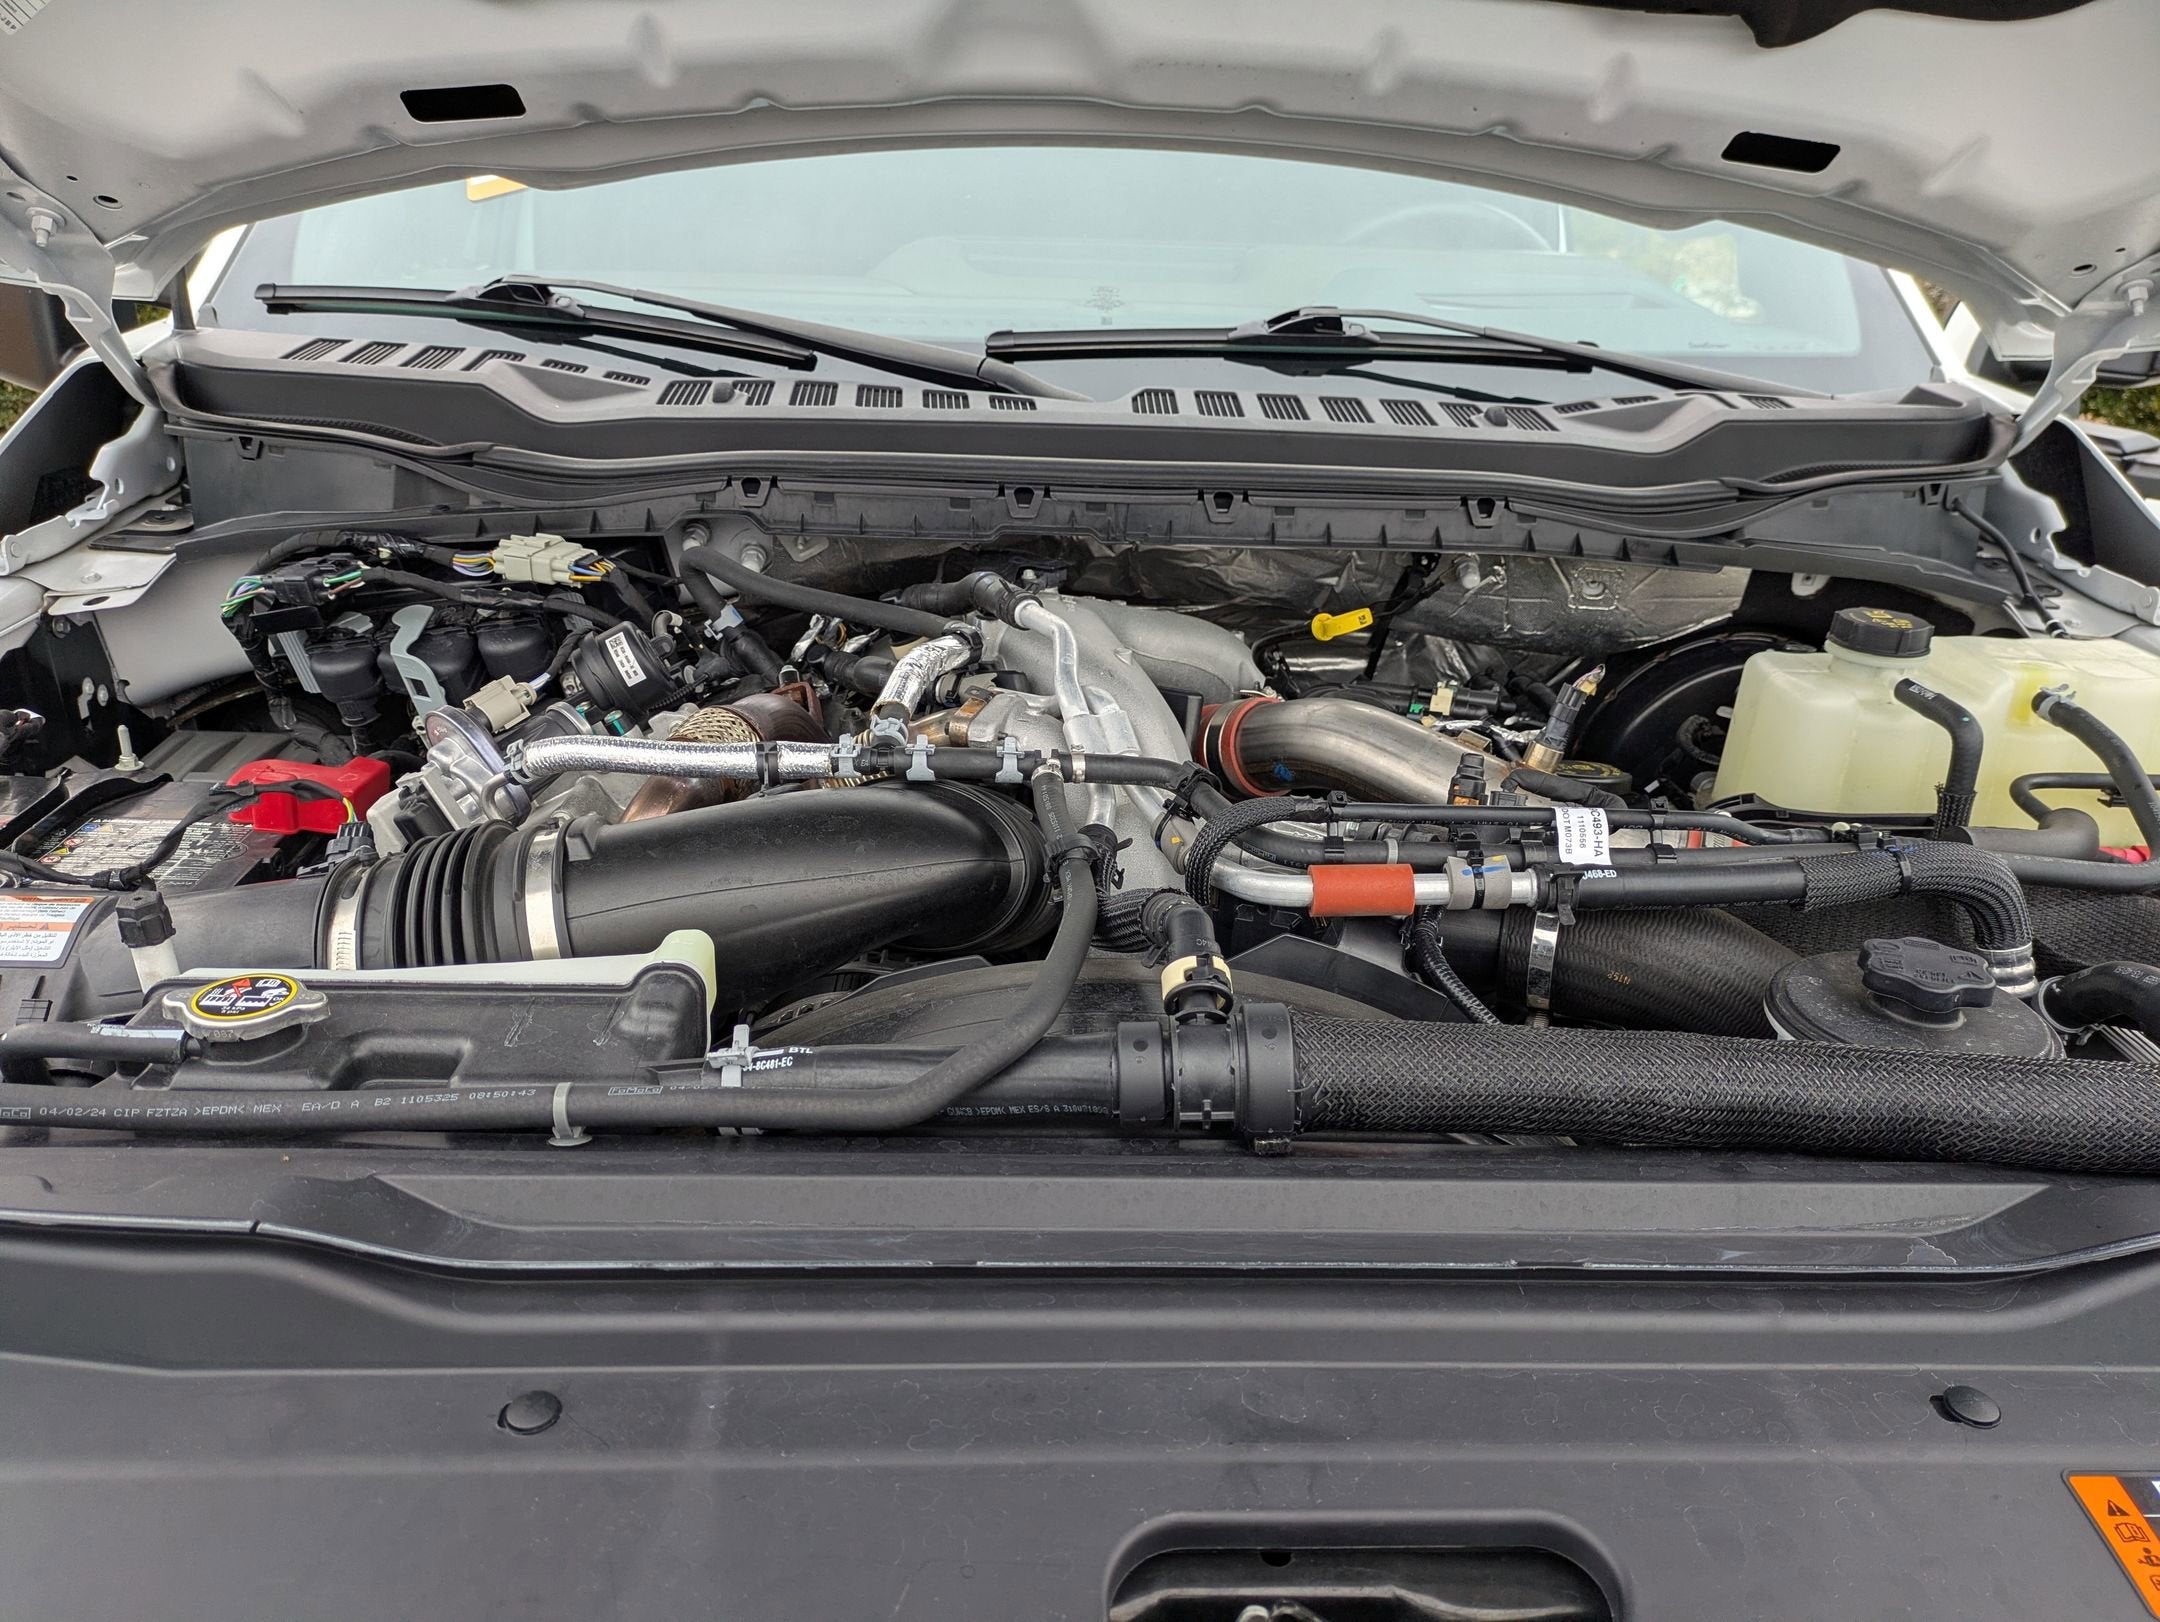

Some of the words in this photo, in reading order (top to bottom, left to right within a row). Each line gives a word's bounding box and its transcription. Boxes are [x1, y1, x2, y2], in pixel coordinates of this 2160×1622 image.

[39, 1107, 107, 1118] 04/02/24
[113, 1107, 140, 1118] CIP
[253, 1104, 282, 1113] MEX
[350, 1100, 360, 1109] A
[1009, 1105, 1027, 1115] MEX
